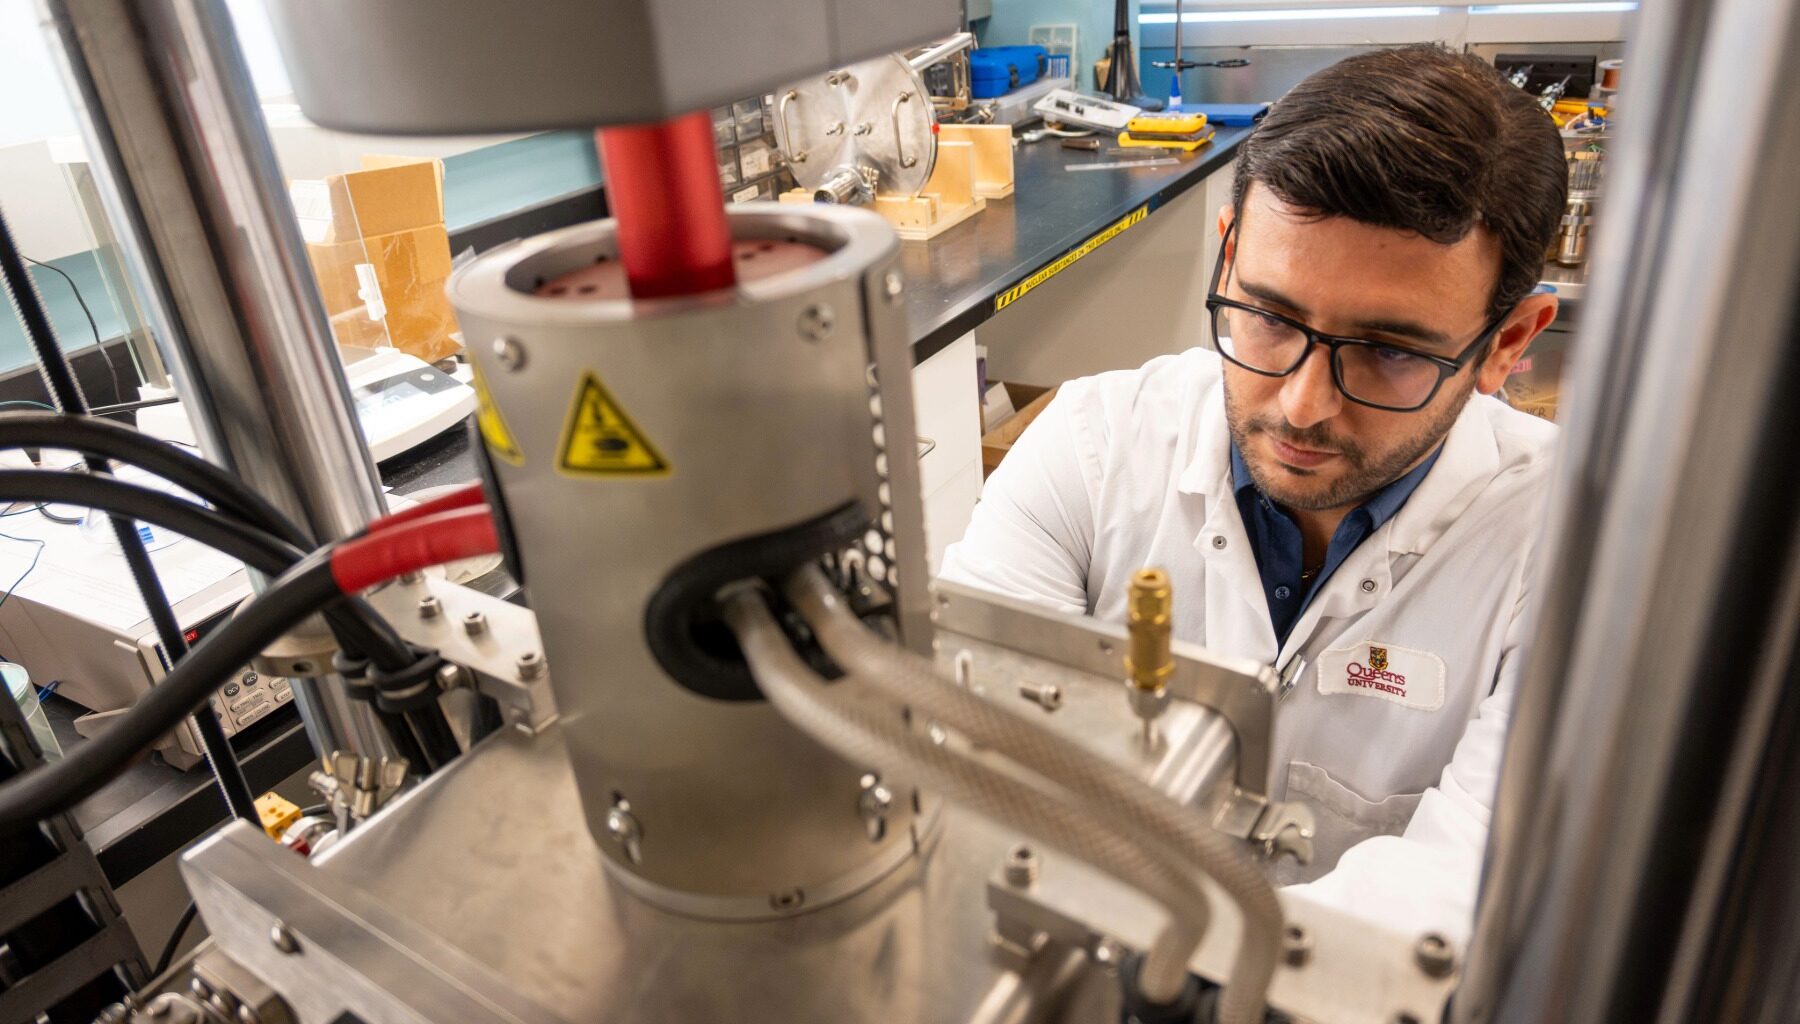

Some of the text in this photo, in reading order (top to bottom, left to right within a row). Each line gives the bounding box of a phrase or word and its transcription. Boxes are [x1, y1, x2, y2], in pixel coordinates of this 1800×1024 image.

[1025, 271, 1048, 289] NUCLEAR
[1048, 253, 1077, 275] SUBSTANCES
[246, 675, 257, 684] ACV
[227, 685, 239, 694] DCV
[1347, 678, 1406, 697] UNIVERSITY
